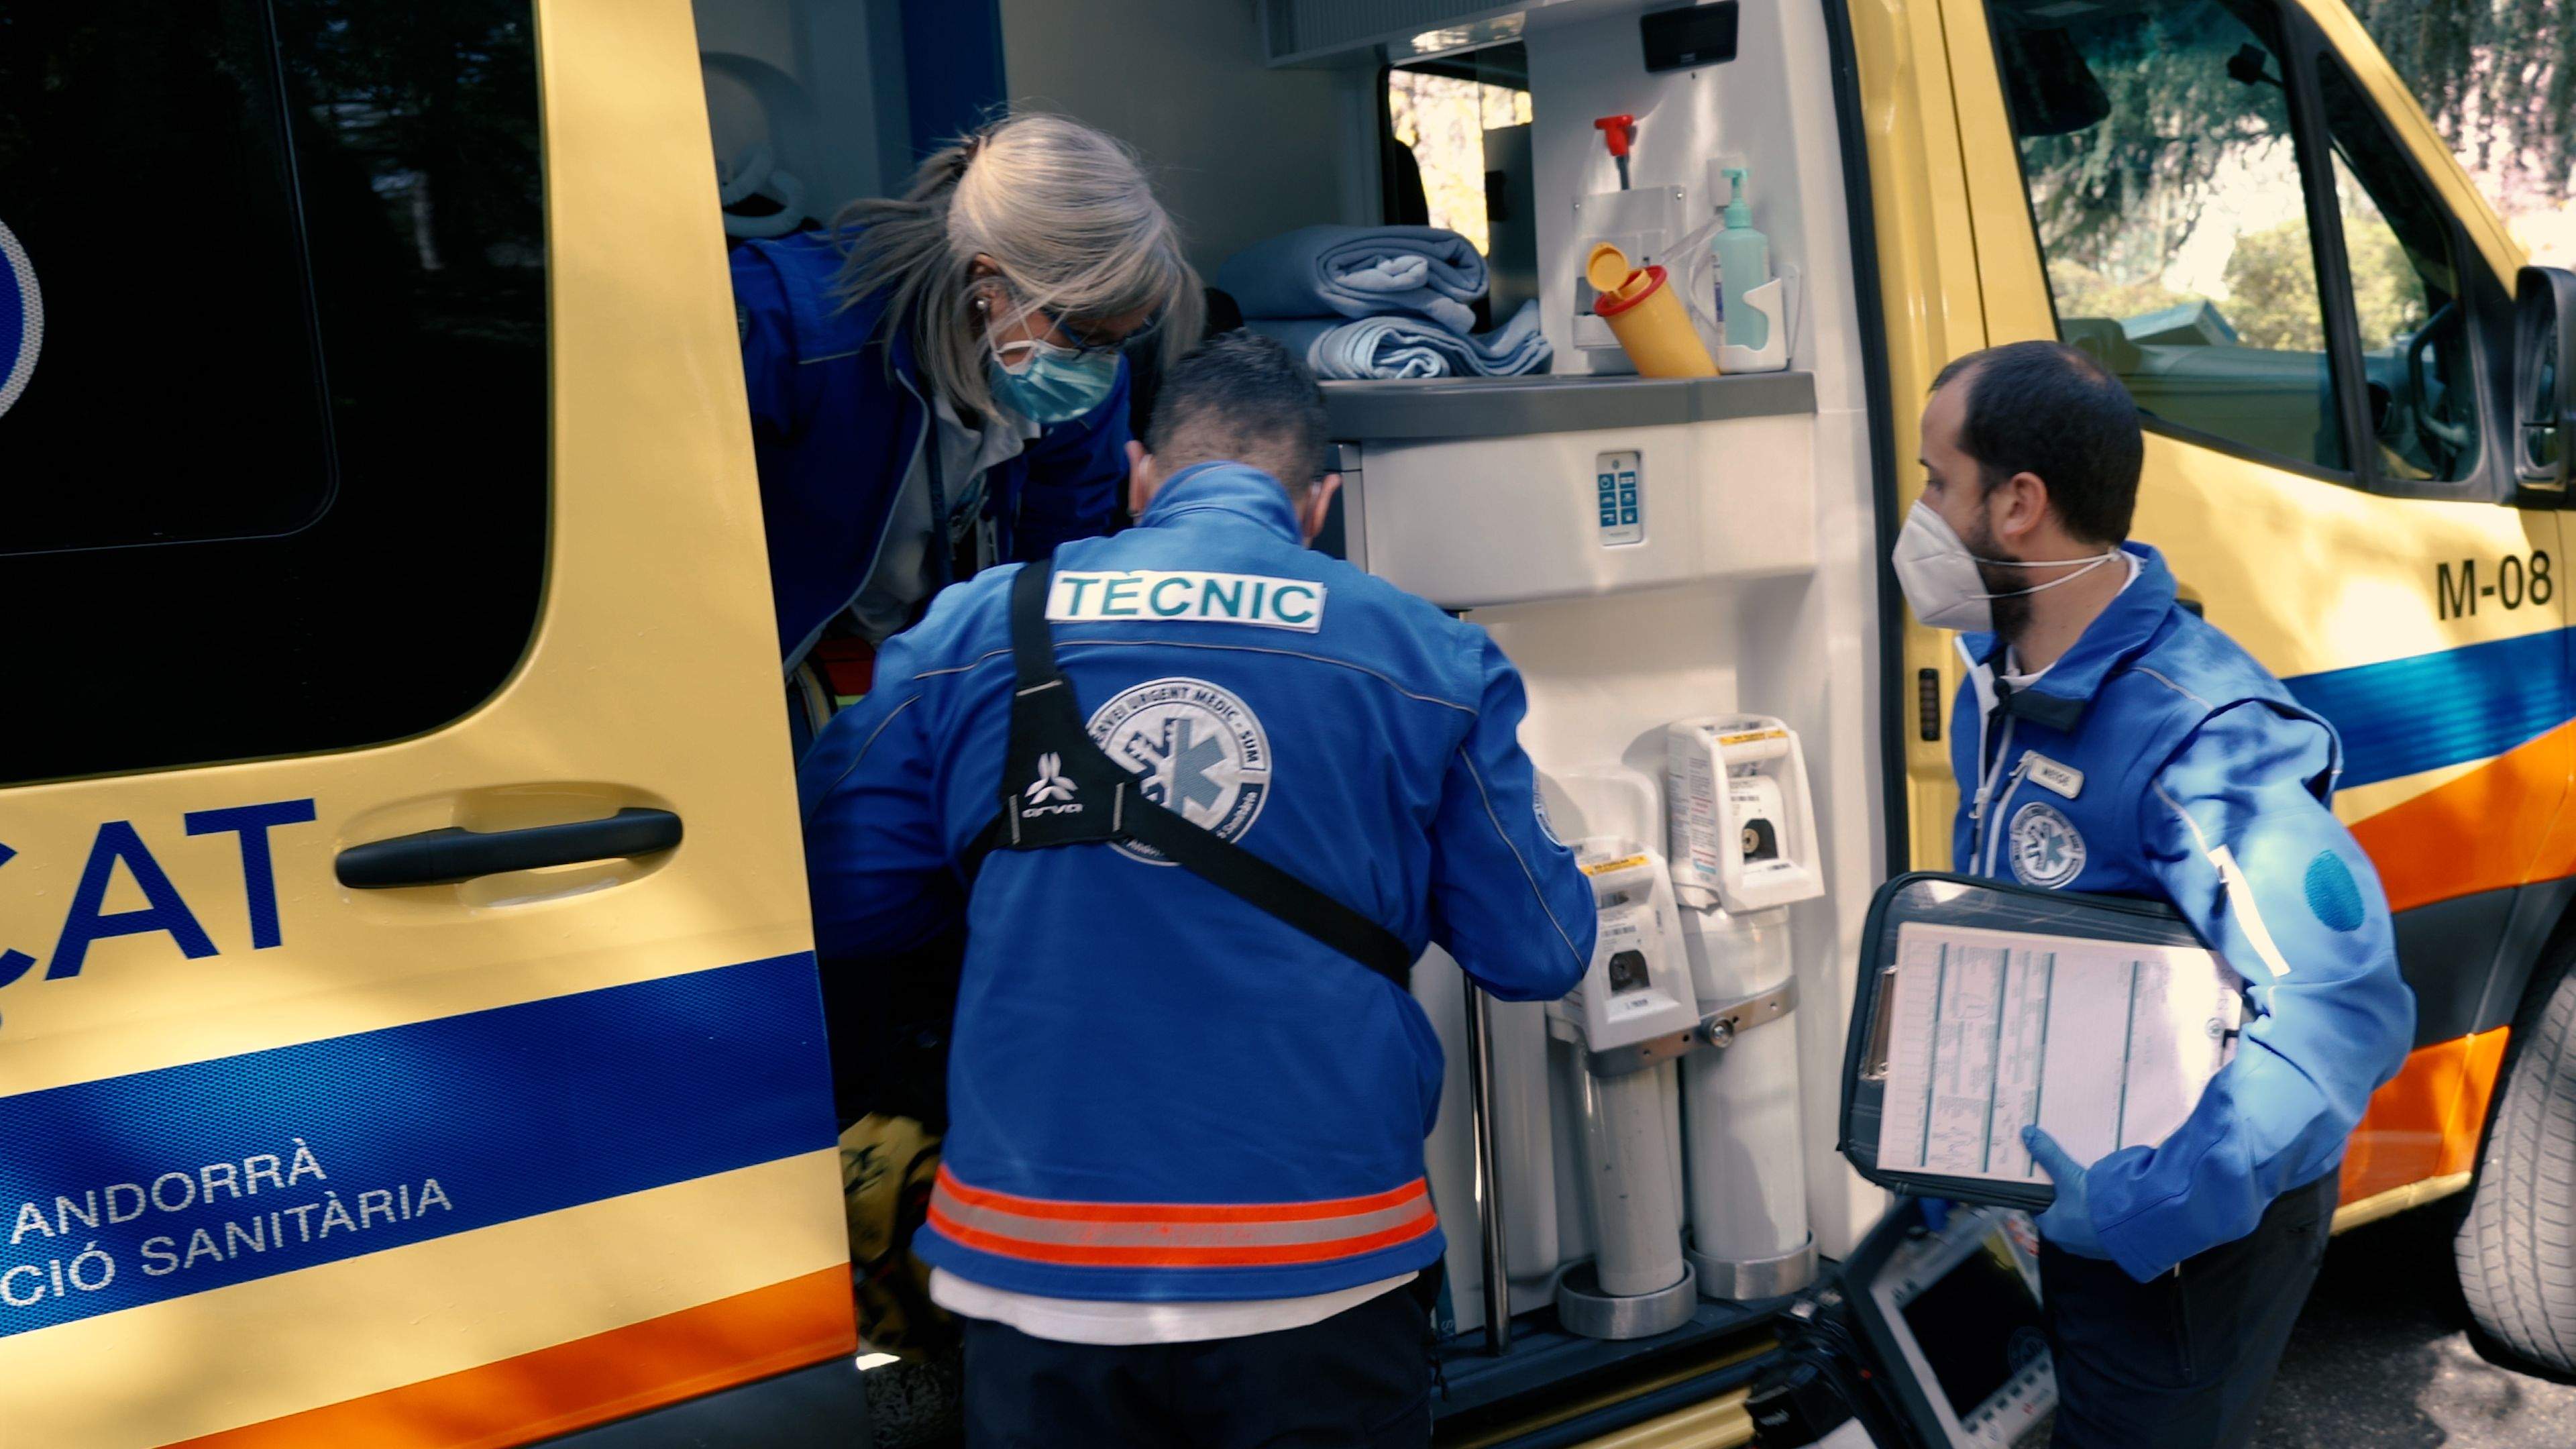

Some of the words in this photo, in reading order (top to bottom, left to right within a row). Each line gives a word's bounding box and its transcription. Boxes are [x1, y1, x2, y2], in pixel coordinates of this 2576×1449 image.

[2436, 549, 2552, 621] M-08
[1239, 730, 1259, 763] SUM
[0, 798, 317, 1030] AT
[9, 1138, 327, 1244] ANDORRÀ
[141, 1178, 453, 1275] SANITÀRIA
